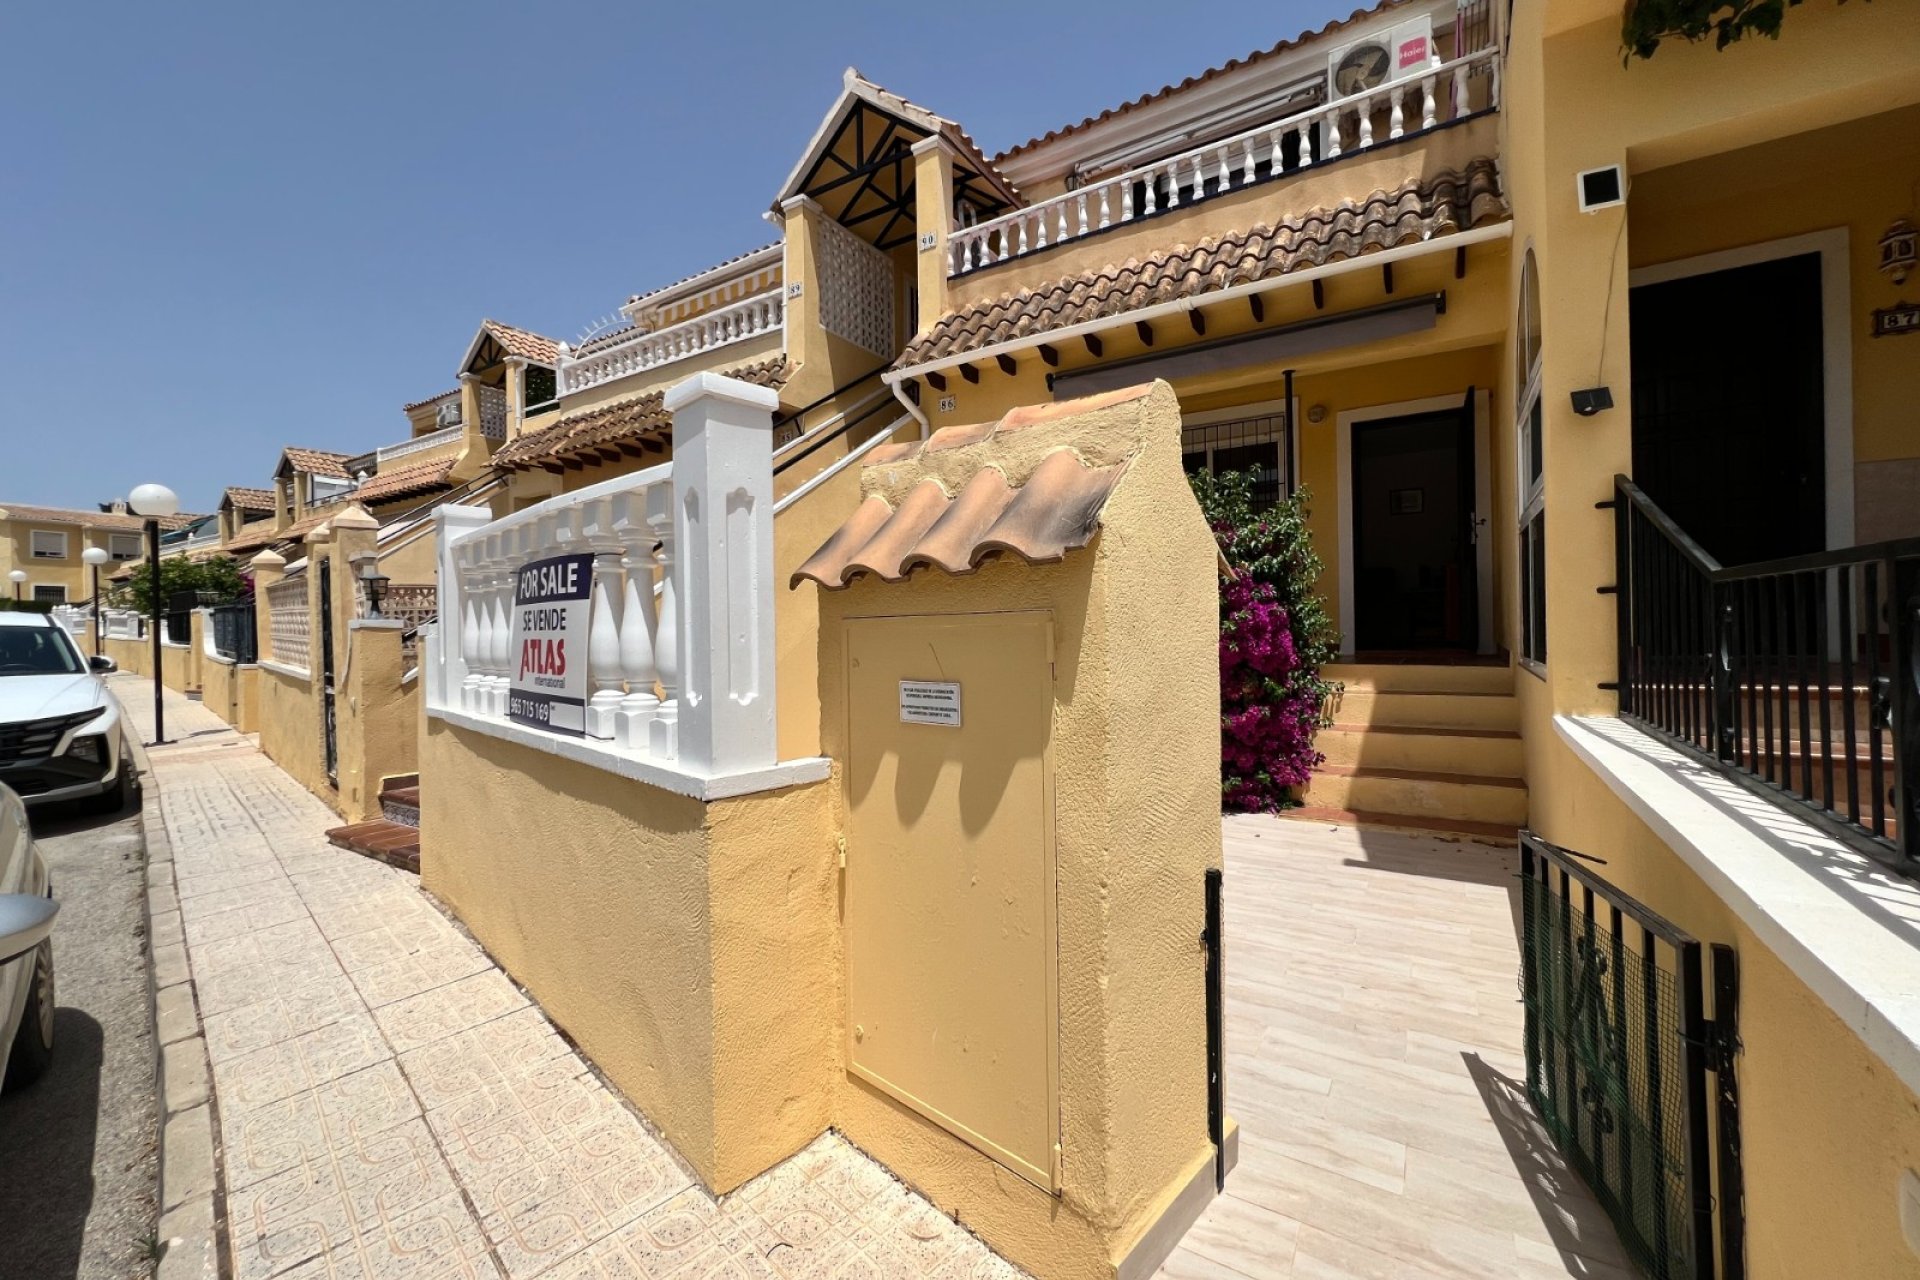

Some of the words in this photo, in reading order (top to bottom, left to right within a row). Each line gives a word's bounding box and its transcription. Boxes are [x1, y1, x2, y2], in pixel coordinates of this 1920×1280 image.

[1399, 46, 1425, 60] Haier
[922, 235, 933, 245] 90
[1887, 312, 1917, 327] 87
[941, 399, 954, 410] 86
[520, 569, 539, 600] FOR
[540, 562, 579, 597] SALE
[523, 610, 533, 631] SE
[533, 608, 567, 631] VENDE
[519, 638, 566, 682] ATLAS
[534, 677, 566, 689] international
[522, 699, 535, 718] 715
[535, 702, 549, 721] 169
